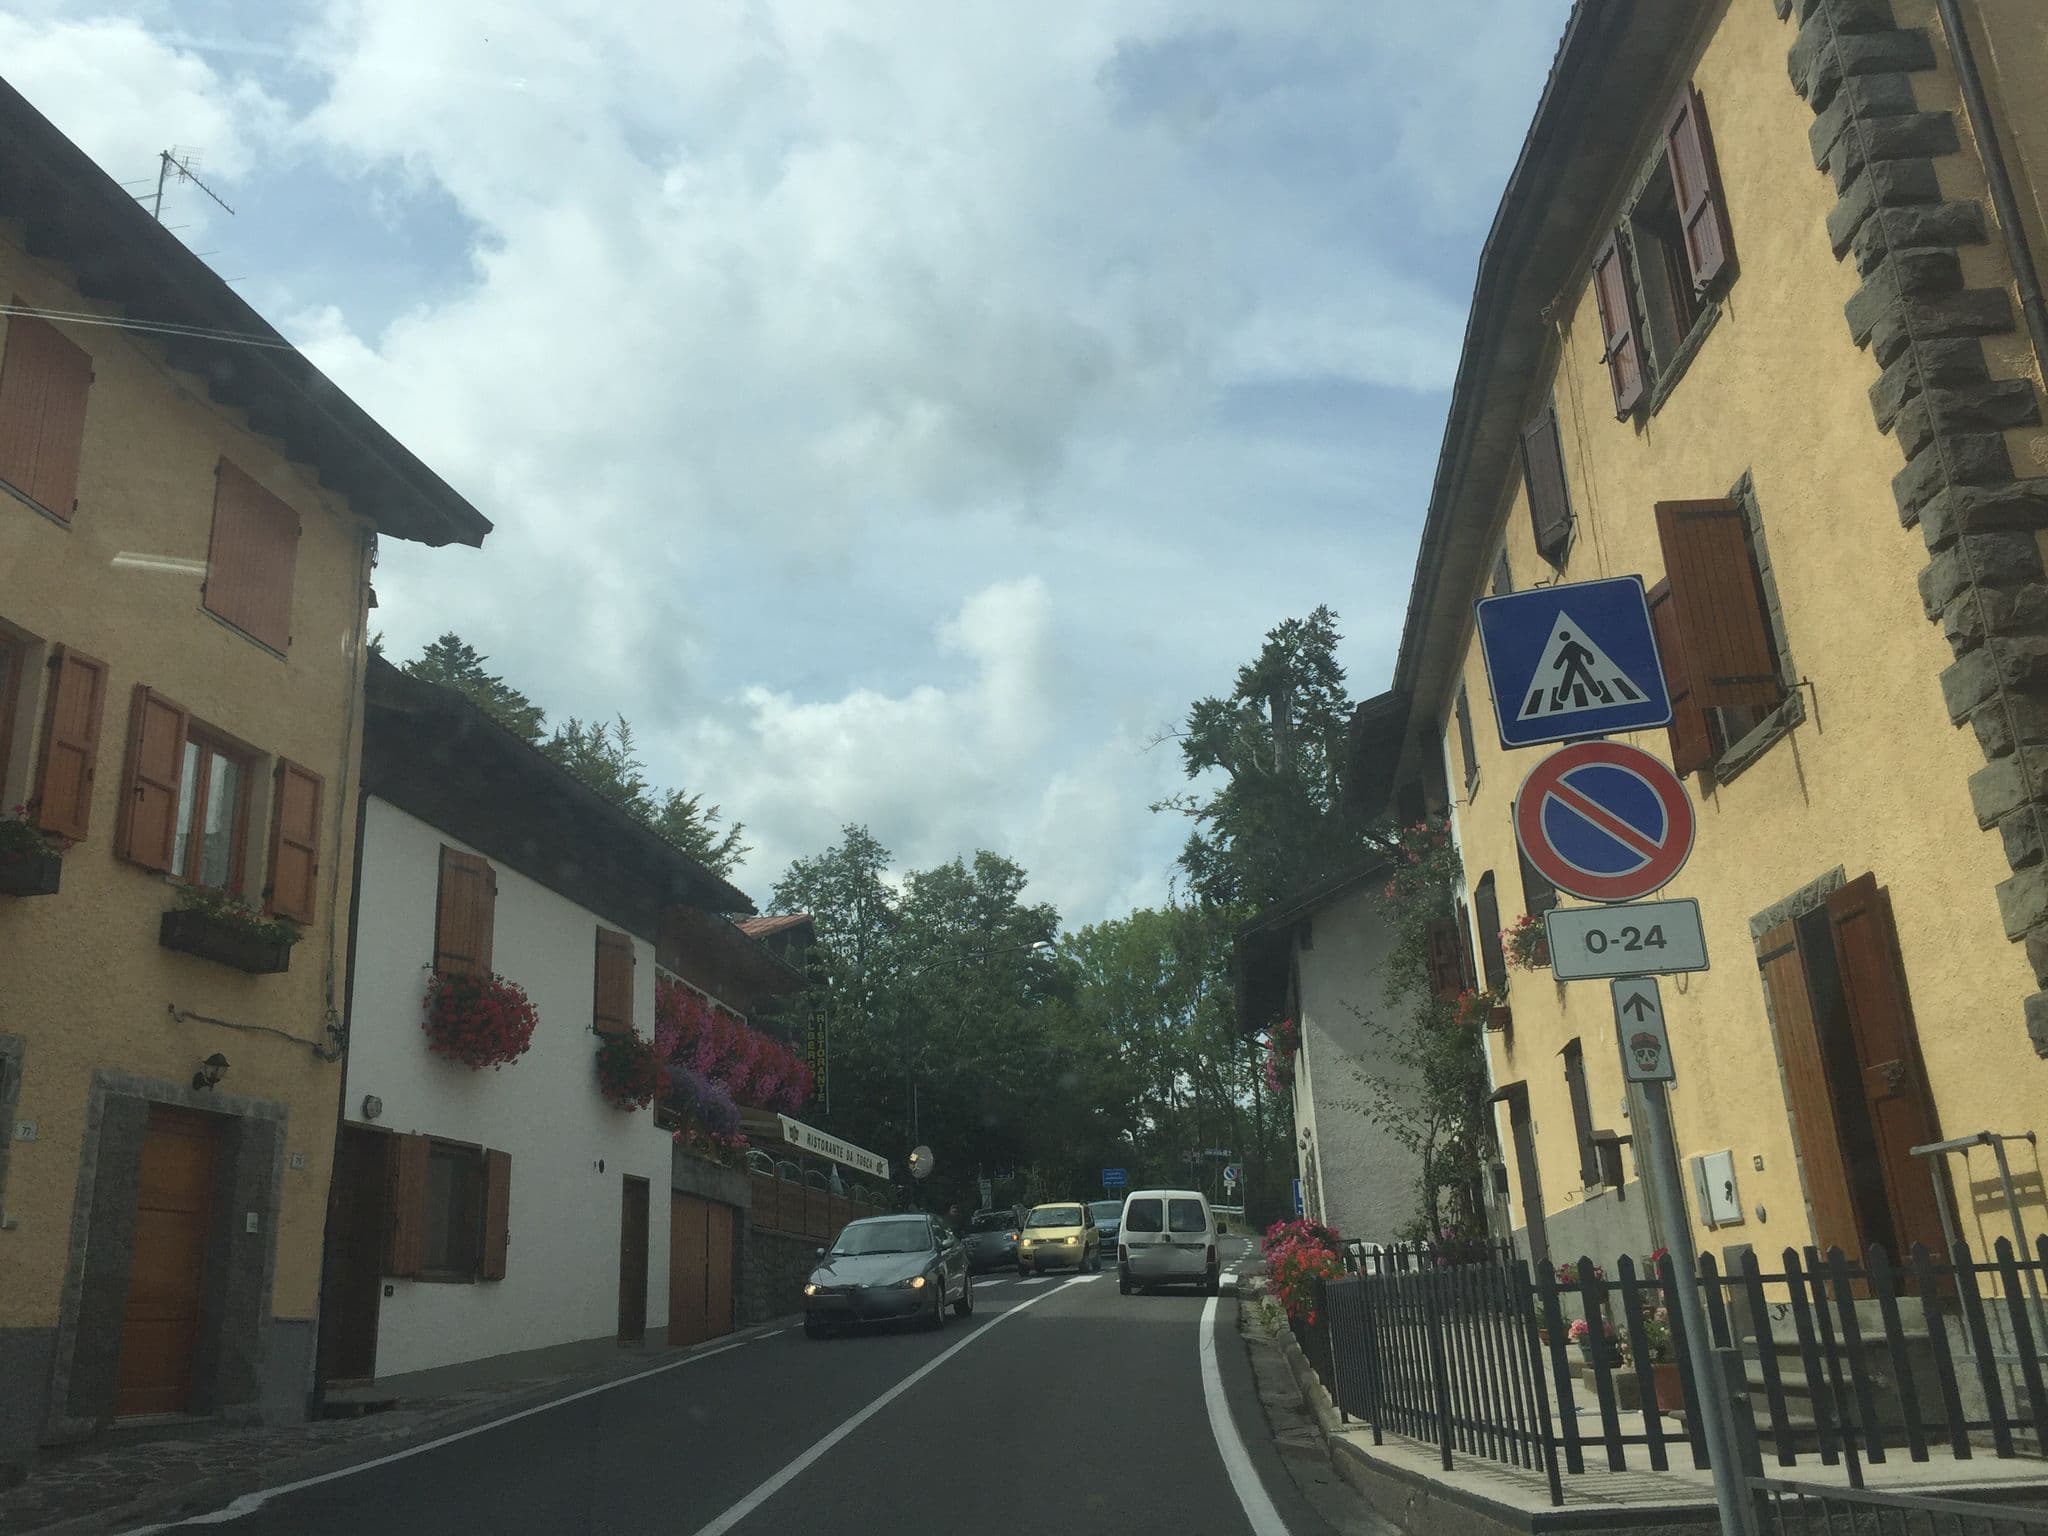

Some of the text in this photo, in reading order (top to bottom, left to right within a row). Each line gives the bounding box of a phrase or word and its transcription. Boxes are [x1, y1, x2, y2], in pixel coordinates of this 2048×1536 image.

[1585, 924, 1668, 954] 0-24
[817, 1014, 825, 1102] RISTORANTE
[807, 1133, 843, 1159] RISTORANTE
